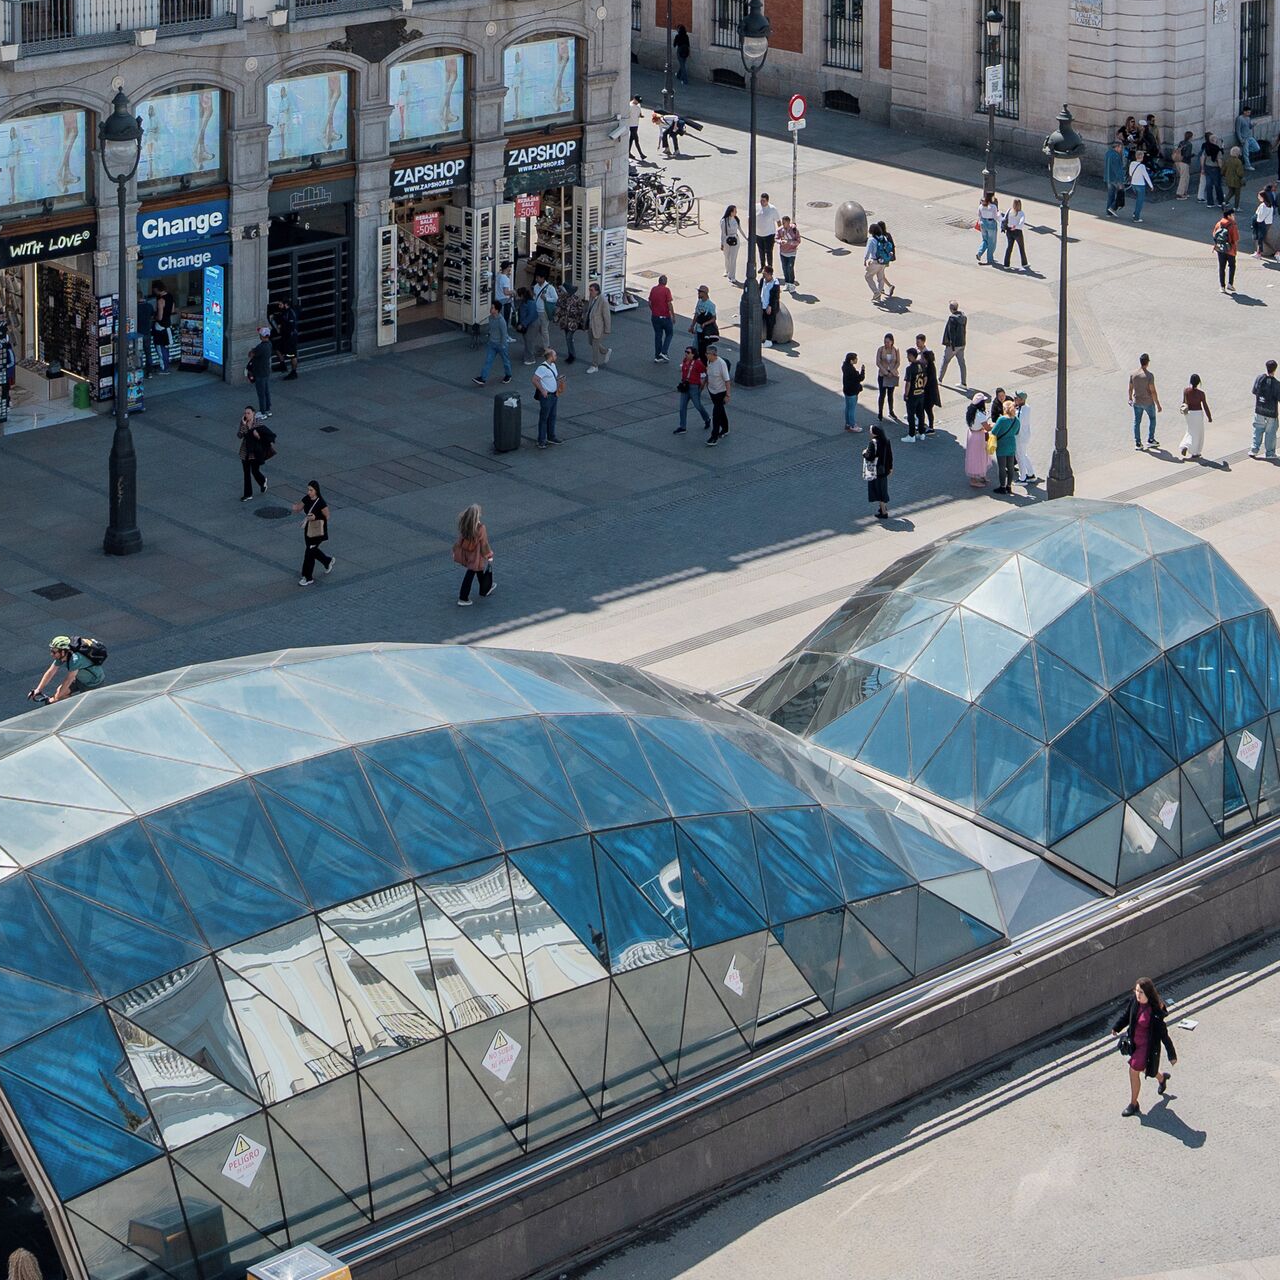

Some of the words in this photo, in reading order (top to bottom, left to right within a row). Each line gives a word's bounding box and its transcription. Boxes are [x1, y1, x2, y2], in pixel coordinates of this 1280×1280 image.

[509, 141, 576, 166] ZAPSHOP
[394, 159, 465, 186] ZAPSHOP
[518, 159, 565, 173] WWW.ZAPSHOP.ES
[404, 179, 453, 193] WWW.ZAPSHOP.ES
[518, 207, 537, 217] -50%
[142, 212, 222, 239] Change
[304, 222, 310, 230] 6
[417, 224, 436, 235] -50%
[251, 229, 257, 238] 6
[10, 241, 43, 258] WITH
[158, 251, 211, 270] Change
[229, 1149, 260, 1171] PELIGRO
